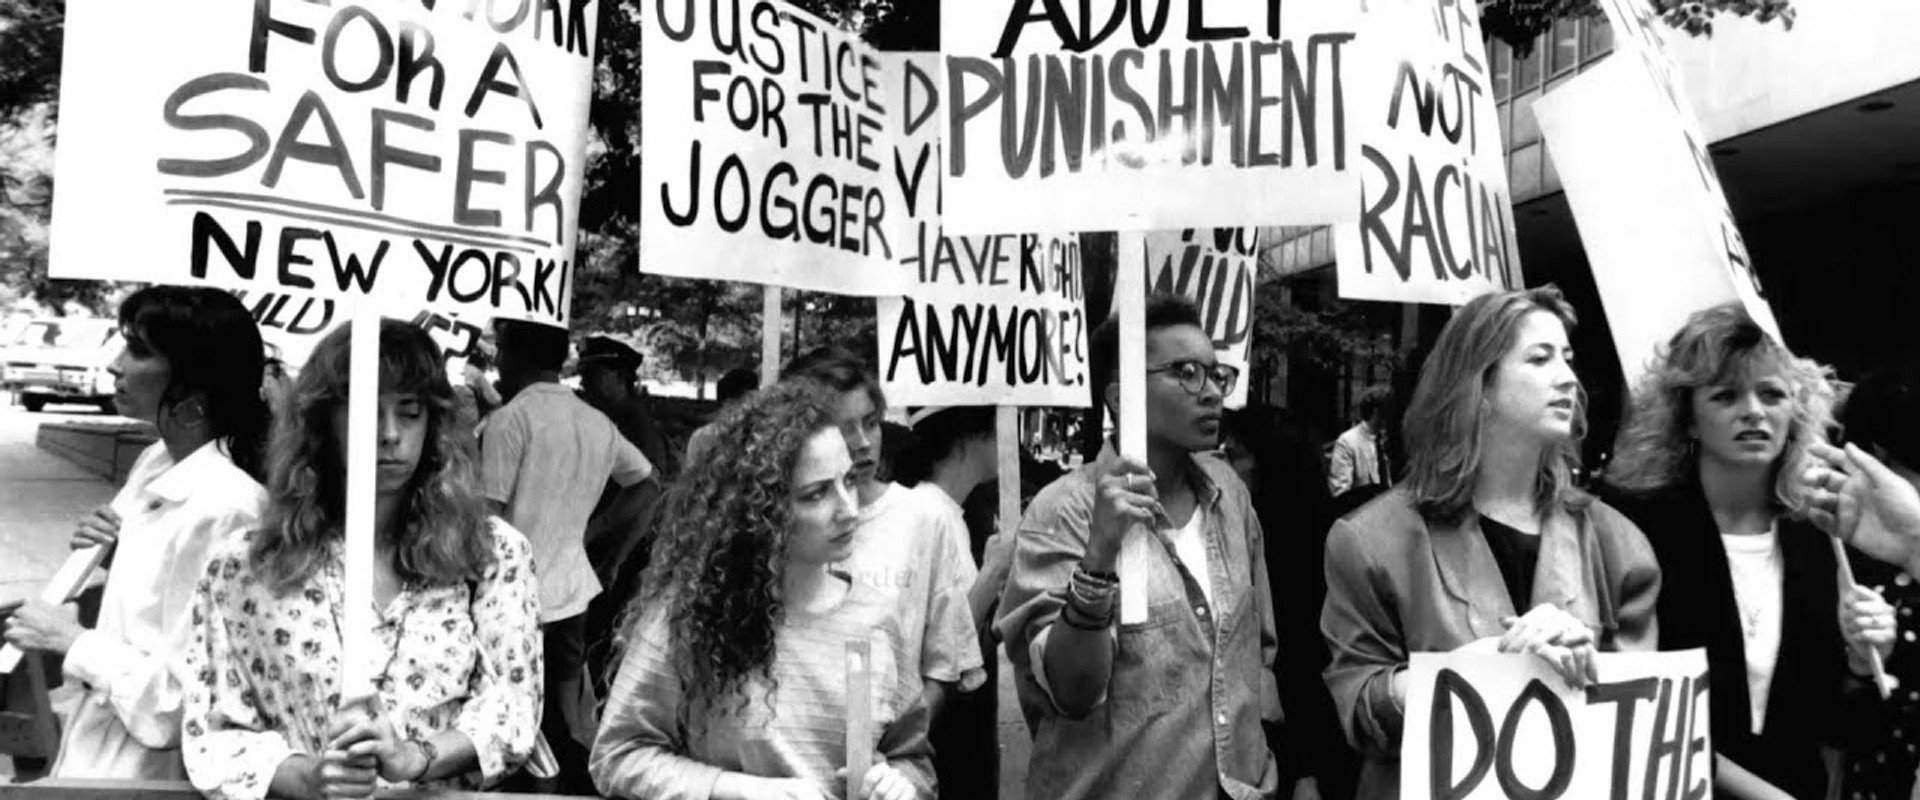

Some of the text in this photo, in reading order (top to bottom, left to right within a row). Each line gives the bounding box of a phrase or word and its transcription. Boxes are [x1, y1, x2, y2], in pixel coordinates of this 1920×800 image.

[249, 0, 542, 130] FOR A
[656, 0, 886, 115] JUSTICE
[946, 32, 1357, 180] PUNISHMENT
[1387, 58, 1483, 155] NOT
[157, 72, 566, 247] SAFER
[693, 60, 883, 172] FOR THE
[660, 140, 892, 260] JOGGER
[900, 221, 1018, 286] HAVE
[191, 211, 569, 322] NEW YORK!
[886, 295, 1085, 388] ANYMORE?
[1429, 668, 1710, 800] DO THE
